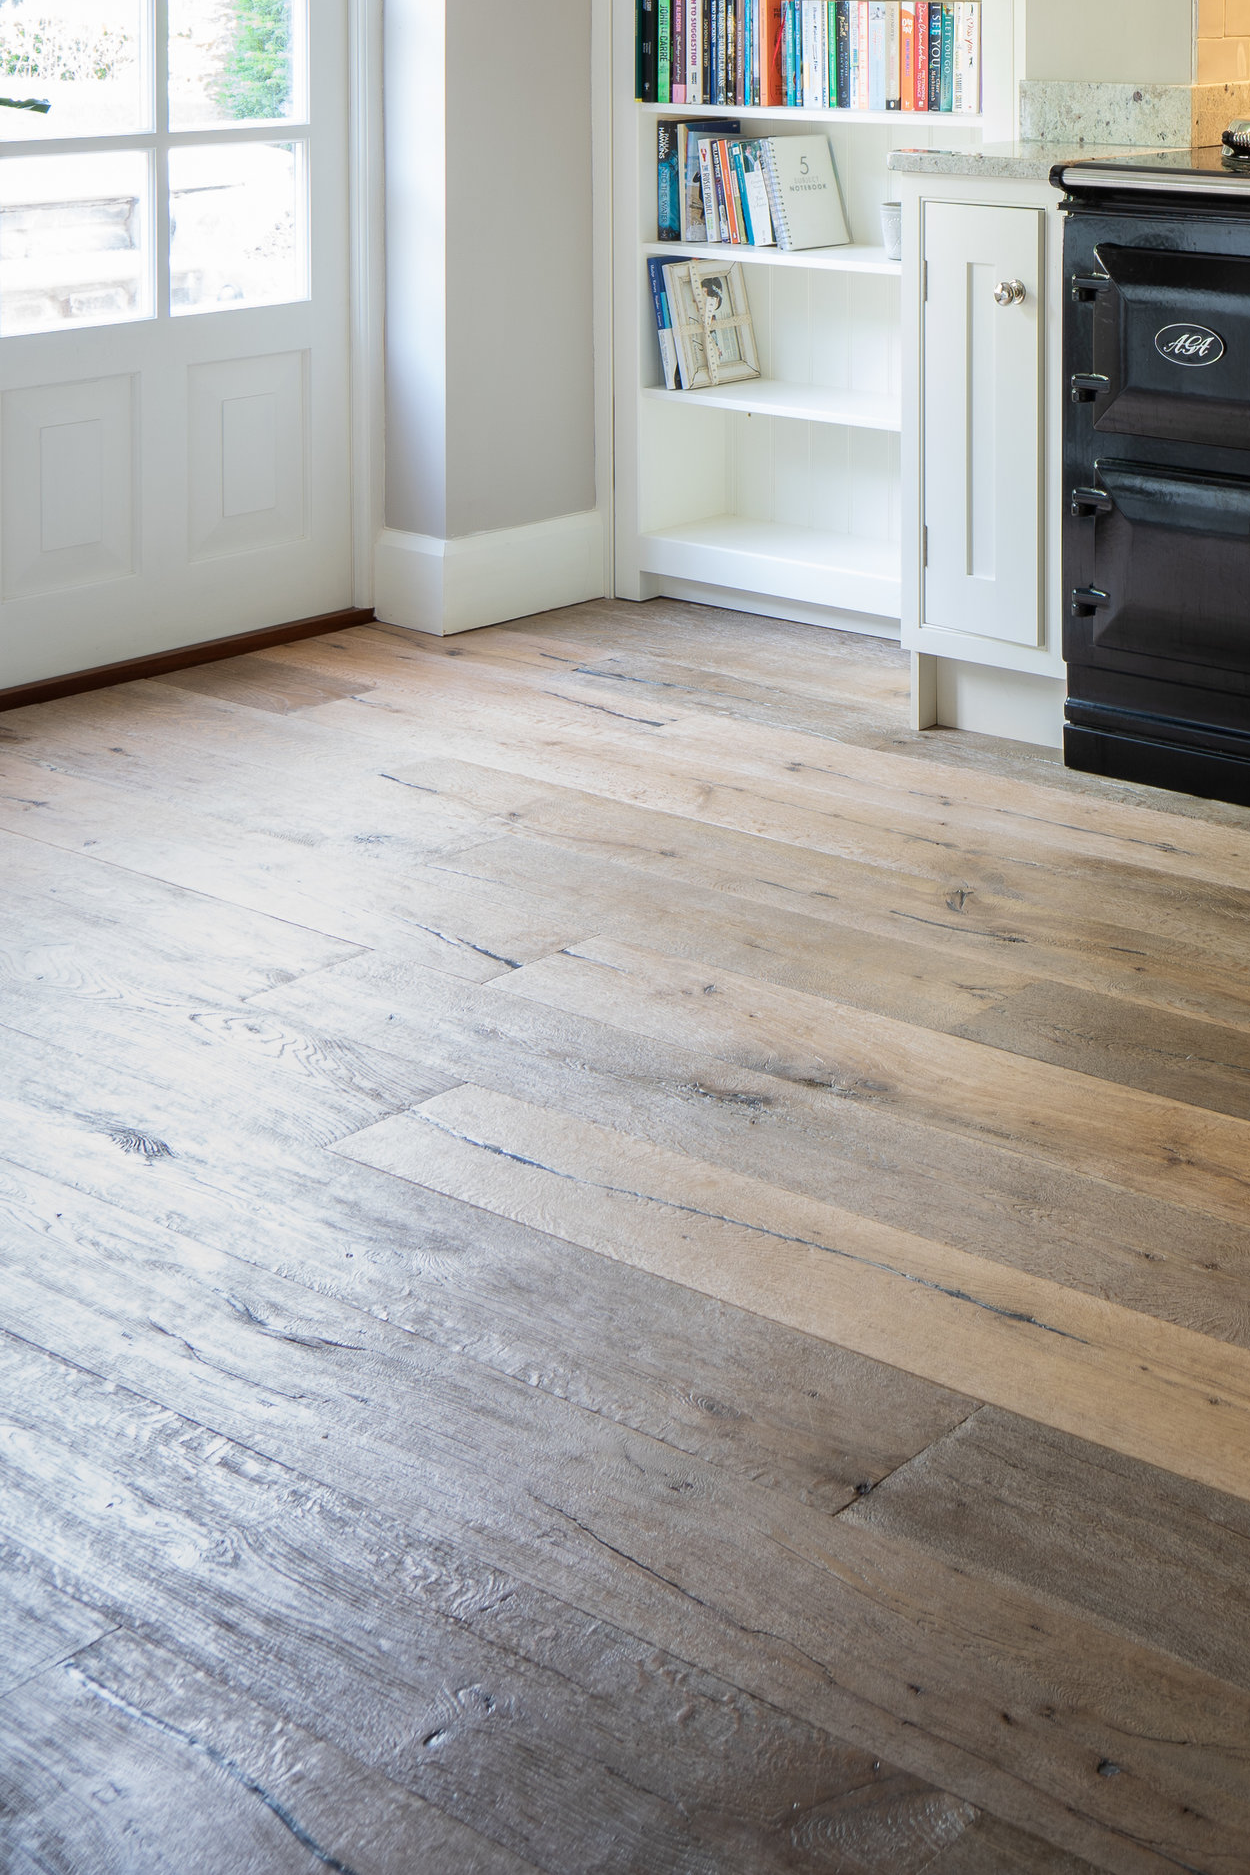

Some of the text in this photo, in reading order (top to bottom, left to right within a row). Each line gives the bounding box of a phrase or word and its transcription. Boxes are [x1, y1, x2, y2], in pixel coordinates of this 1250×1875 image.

[659, 4, 668, 25] JOHN
[690, 5, 697, 16] TO
[932, 14, 941, 36] SEE
[917, 3, 927, 70] Diane Chamberlain
[932, 39, 941, 67] YOU
[944, 60, 951, 74] GO
[800, 156, 809, 175] 5
[789, 183, 827, 192] NOTEBOOK
[794, 176, 819, 184] SUBJECT
[660, 185, 668, 198] THE
[702, 172, 713, 215] ROSIE PROJECT
[660, 199, 668, 223] WATER
[1163, 334, 1215, 357] AGA
